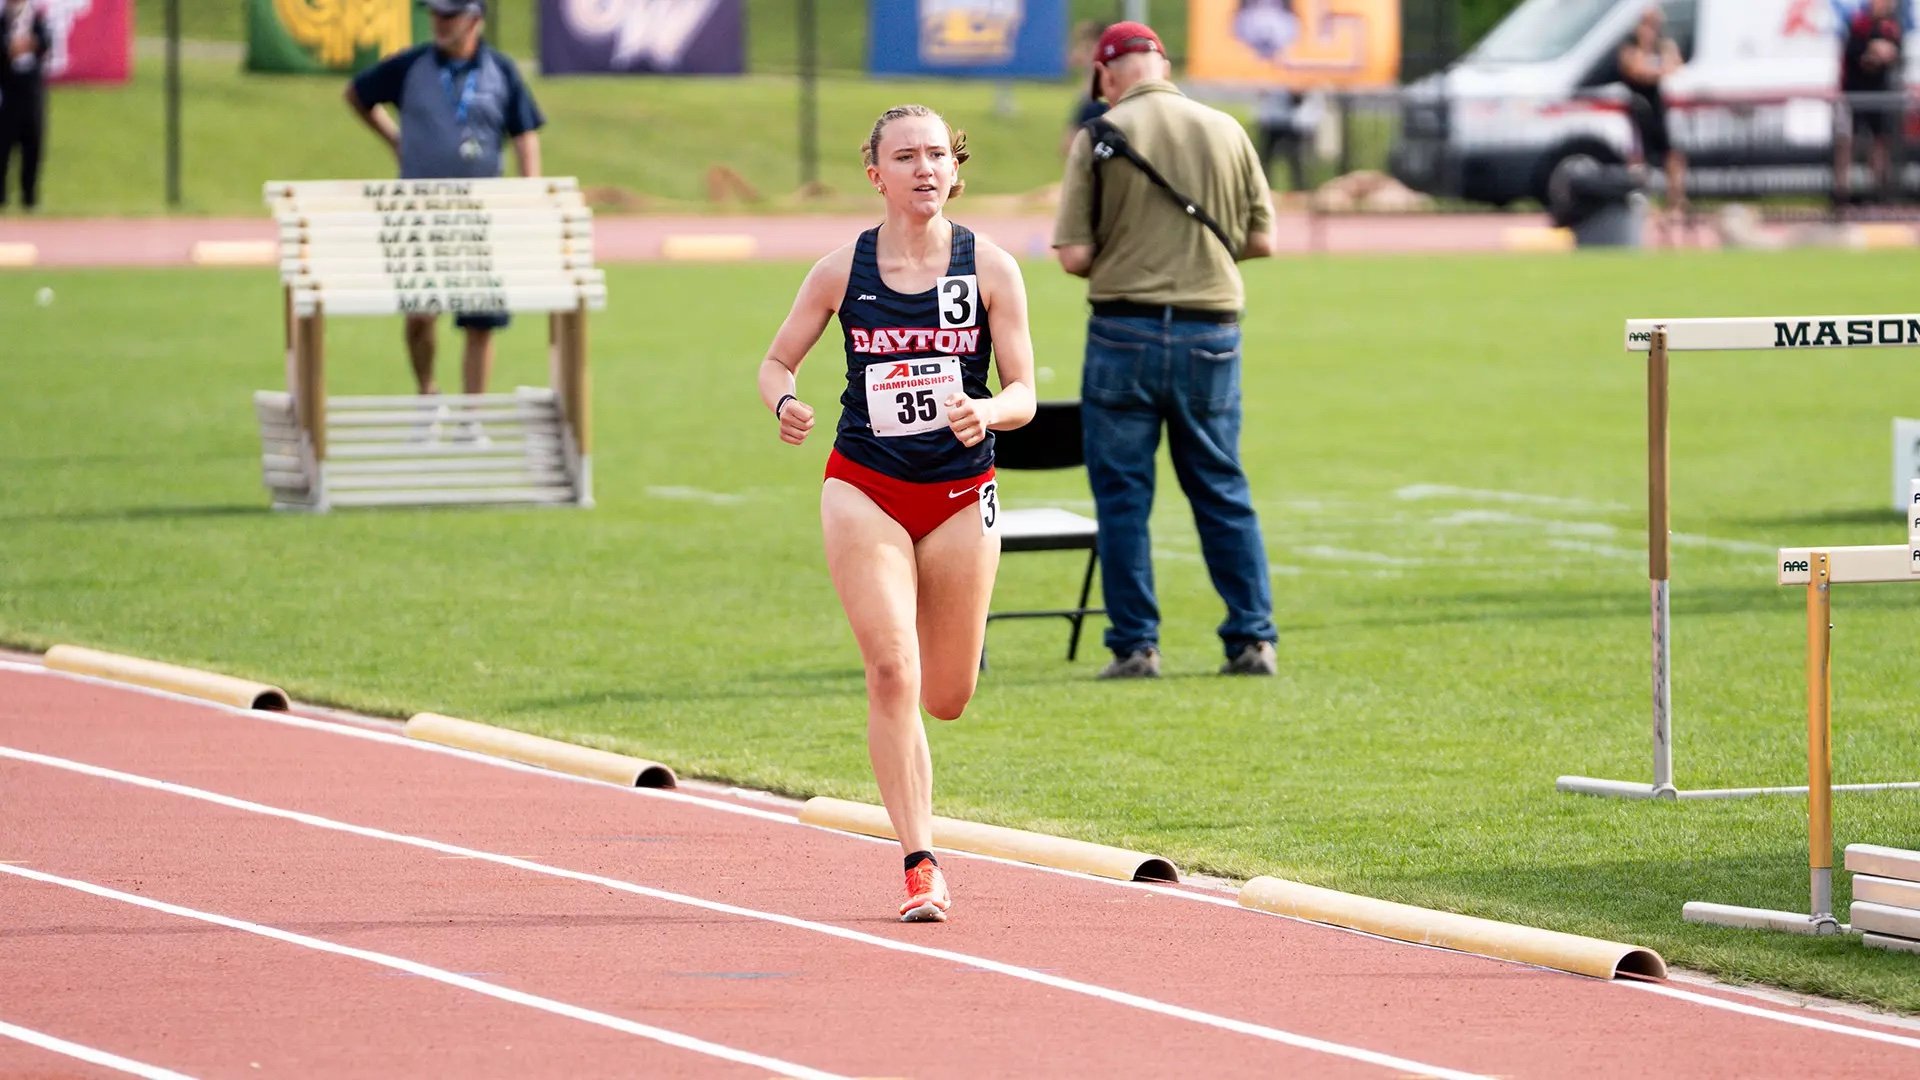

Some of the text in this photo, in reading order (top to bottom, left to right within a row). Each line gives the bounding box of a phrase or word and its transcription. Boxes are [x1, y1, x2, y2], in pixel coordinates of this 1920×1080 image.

[943, 279, 971, 325] 3
[851, 328, 980, 354] DAYTON
[872, 374, 954, 392] CHAMPIONSHIPS
[884, 362, 942, 380] A10
[895, 389, 937, 424] 35
[982, 483, 996, 528] 3
